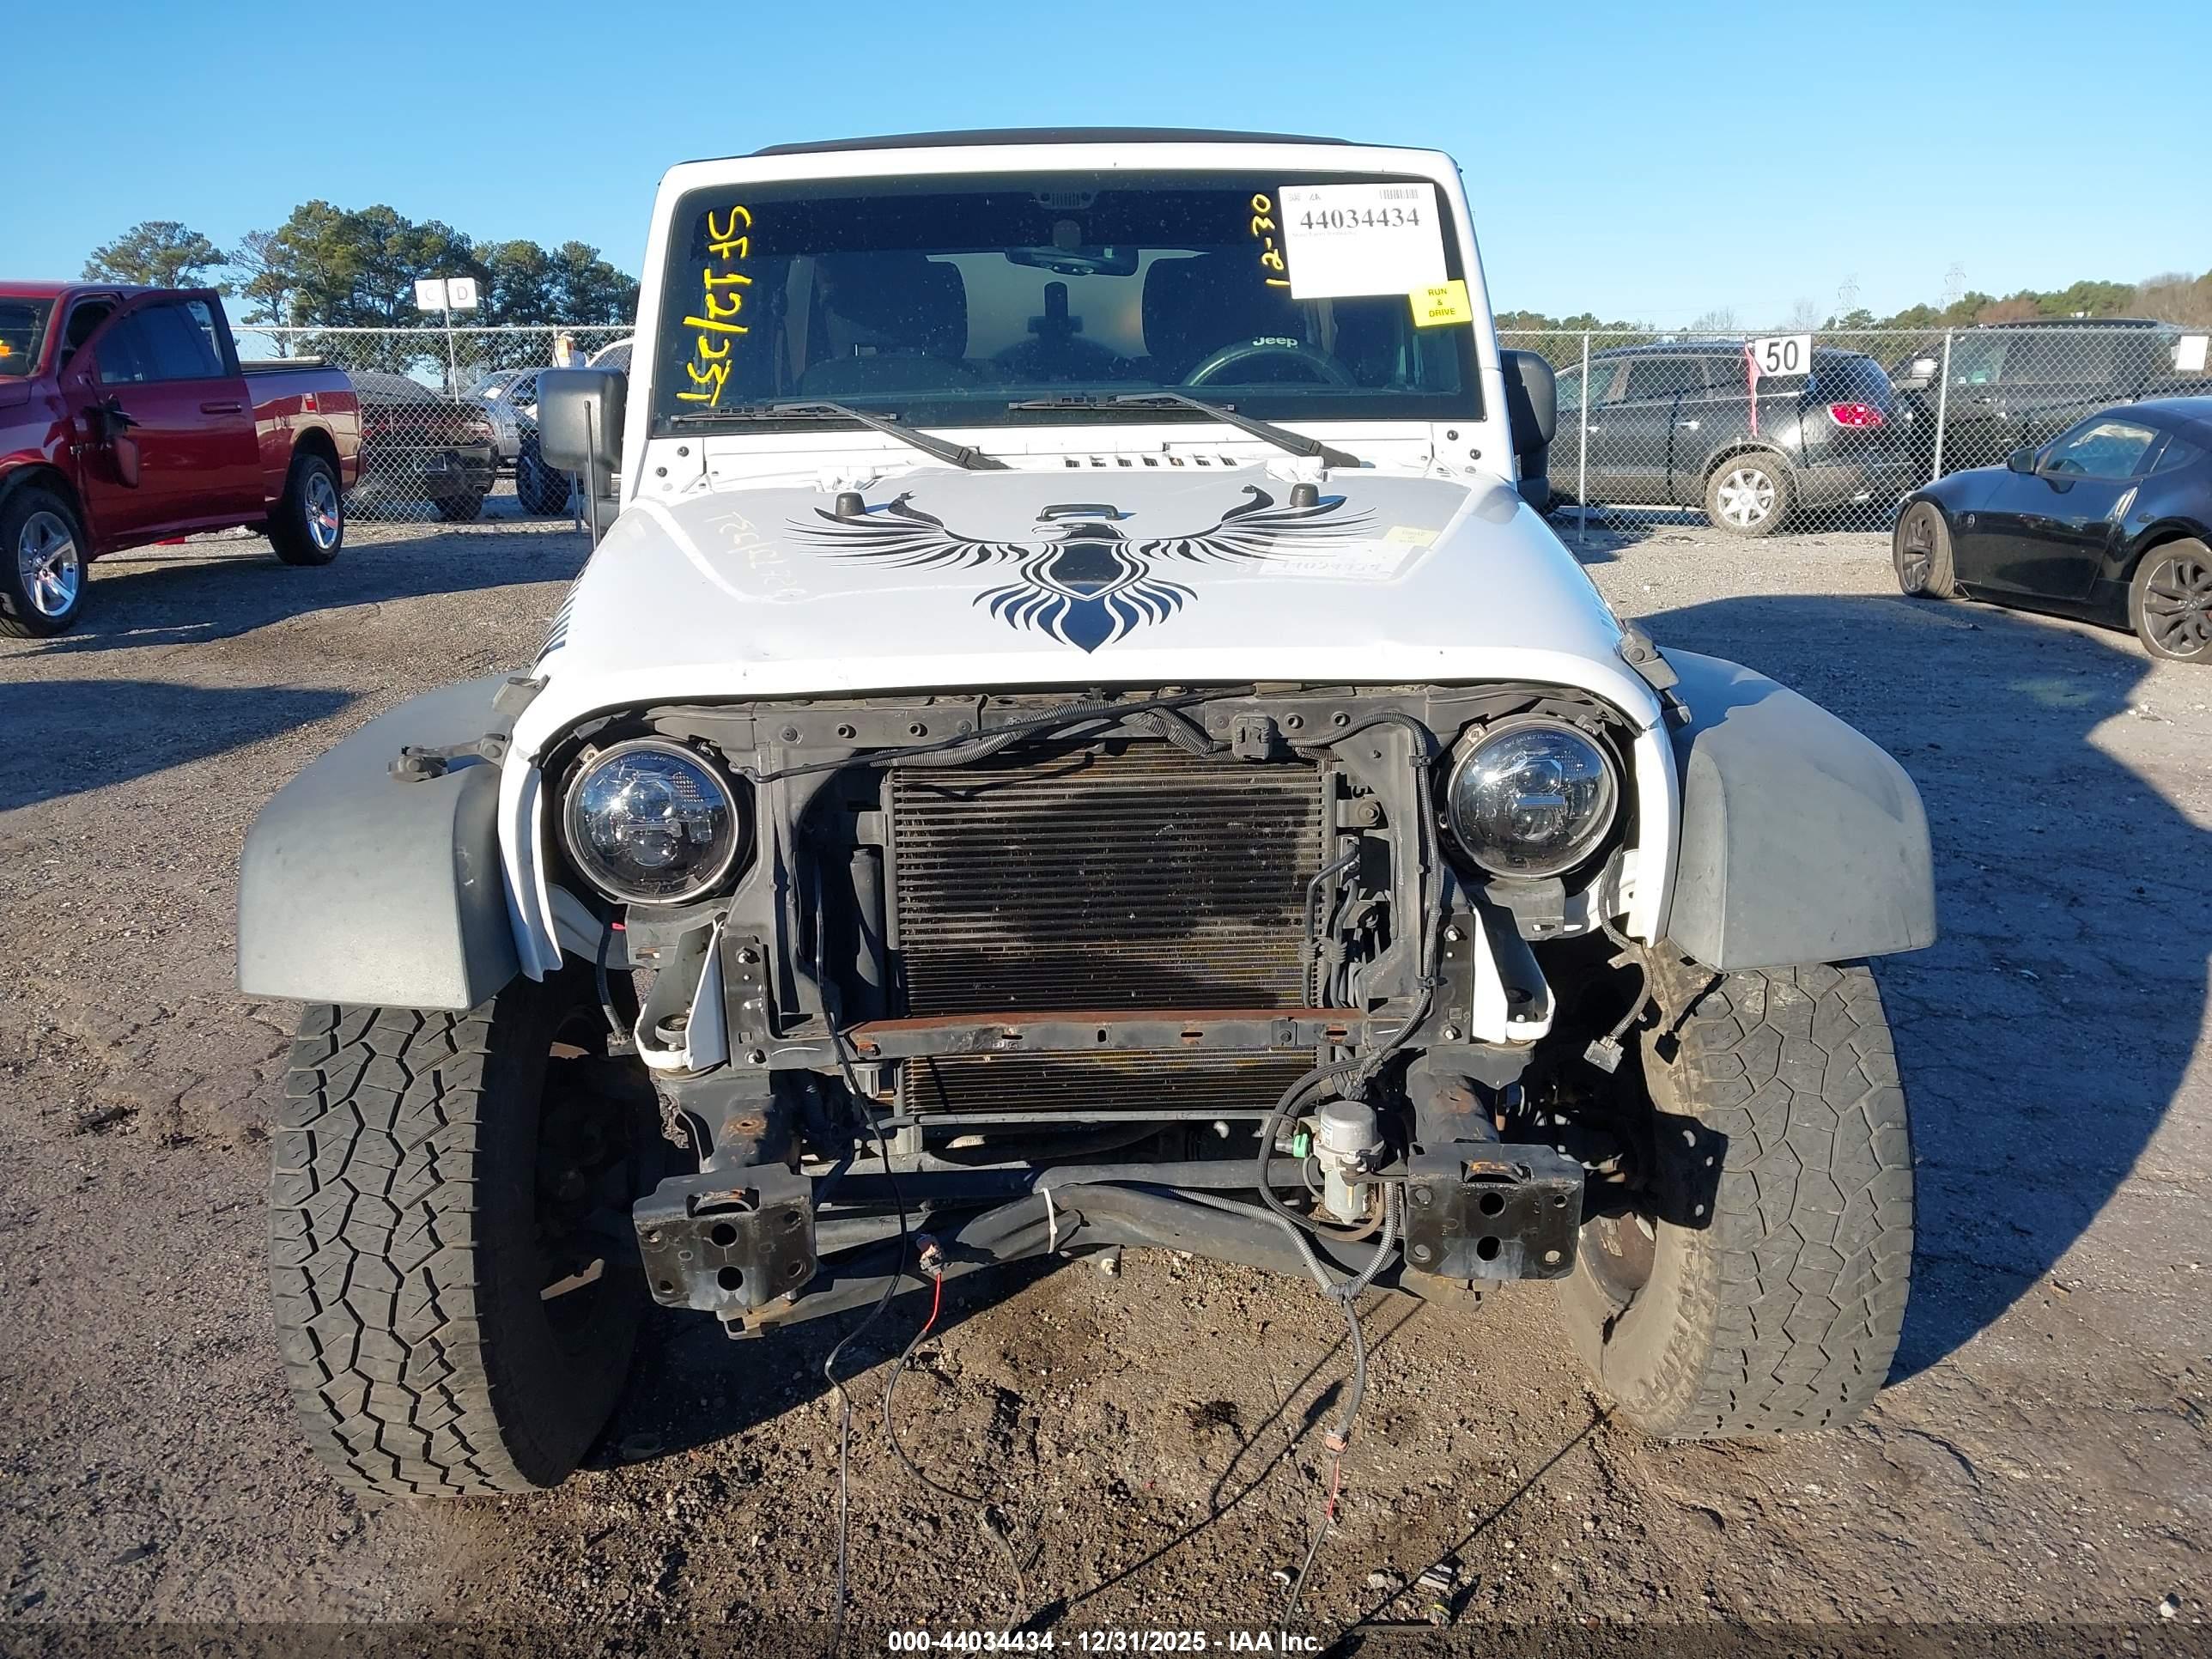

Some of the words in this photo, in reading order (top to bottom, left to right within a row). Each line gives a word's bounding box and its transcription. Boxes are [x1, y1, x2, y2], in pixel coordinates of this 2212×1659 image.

[1300, 207, 1420, 230] 44034434
[708, 205, 752, 258] SF
[1251, 193, 1291, 286] 12-30
[456, 286, 468, 301] D
[1427, 288, 1447, 296] RUN
[1429, 307, 1455, 318] DRIVE
[1253, 337, 1298, 349] Jeep
[1765, 339, 1799, 373] 50
